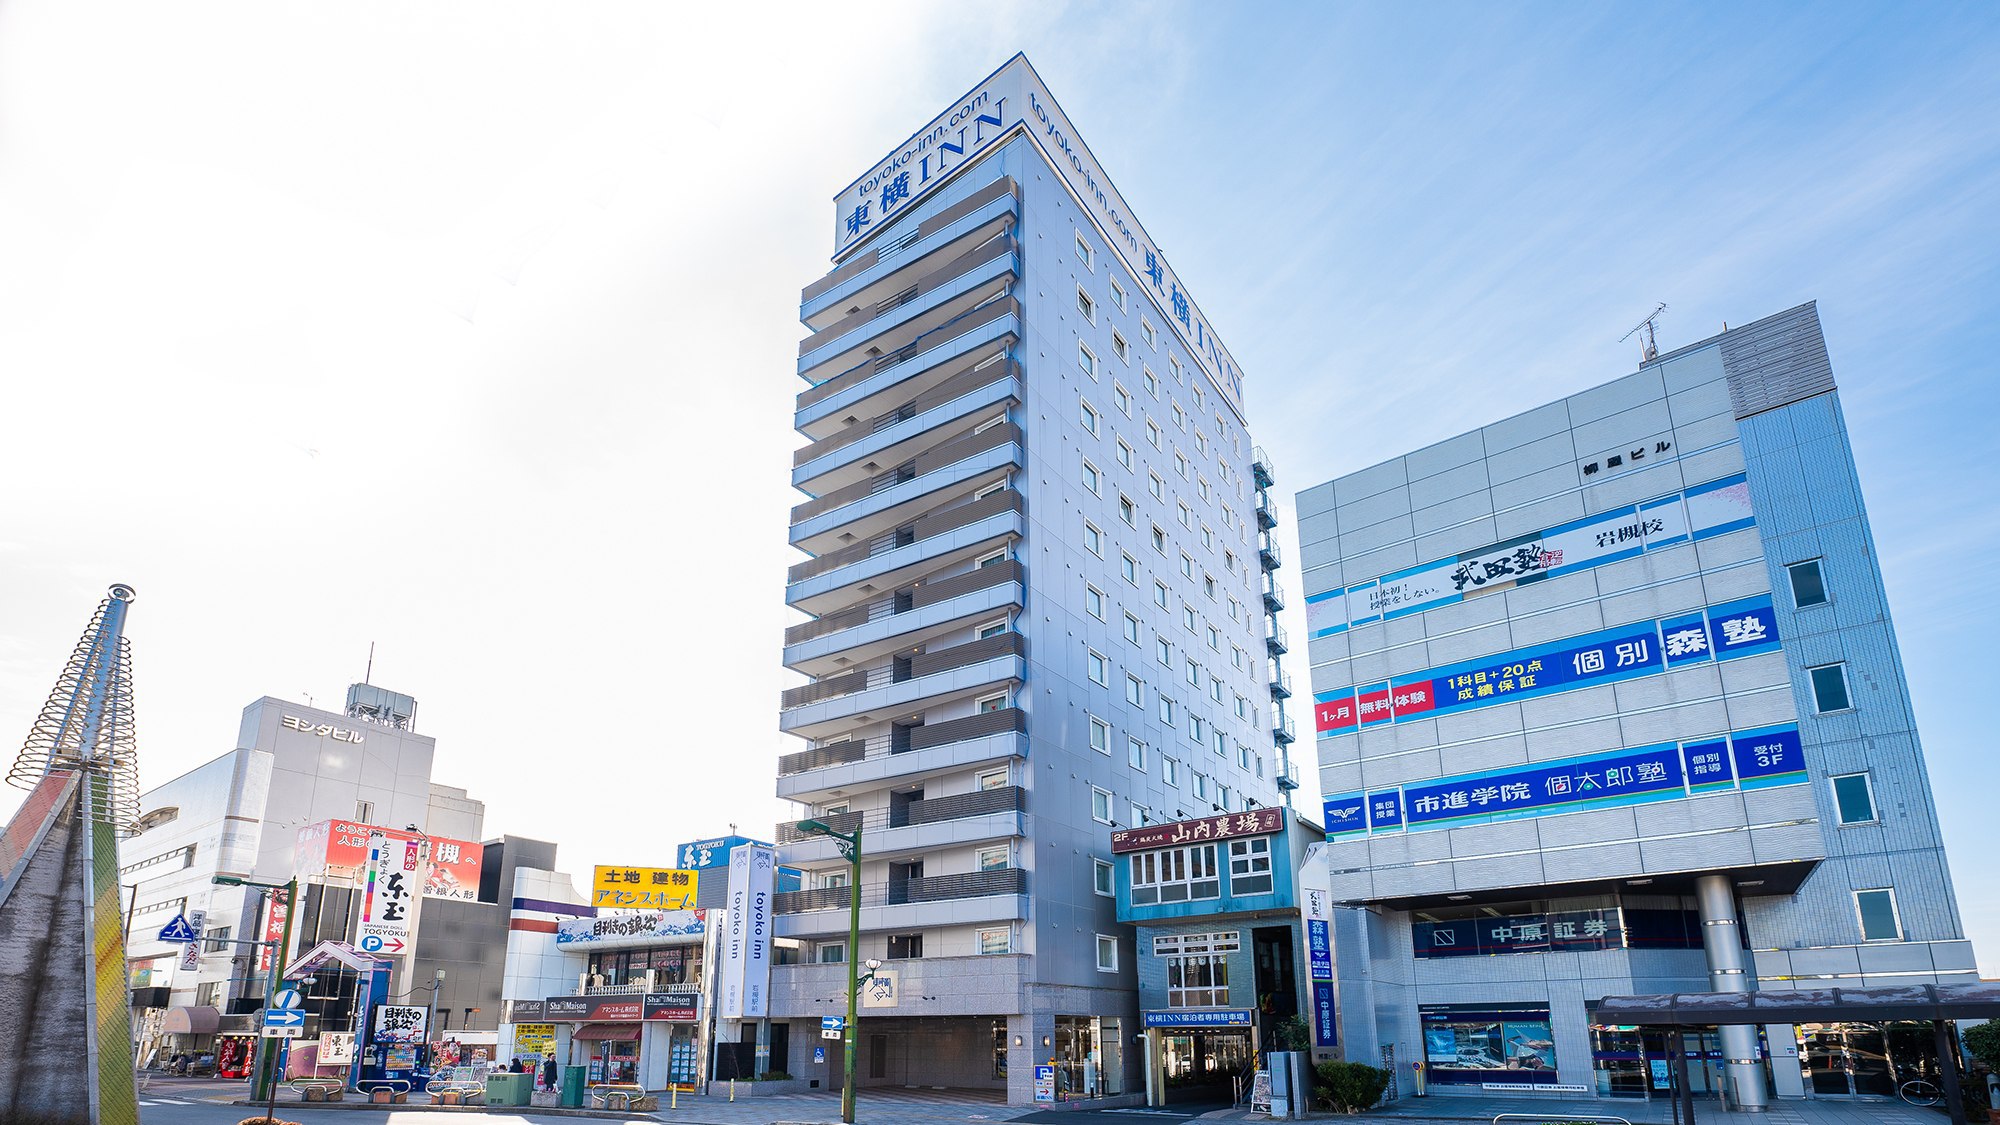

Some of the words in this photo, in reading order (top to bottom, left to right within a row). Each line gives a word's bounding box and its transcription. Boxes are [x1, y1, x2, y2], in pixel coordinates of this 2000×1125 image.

[858, 91, 990, 198] toyoko-inn.com
[1029, 92, 1138, 254] toyoko-inn.com
[1596, 518, 1664, 549] 岩槻校
[1451, 544, 1545, 591] 武田塾
[1457, 675, 1537, 701] 成績保証
[282, 715, 364, 744] ヨシダビル
[1692, 752, 1719, 766] 個別
[1753, 742, 1784, 756] 受付
[1757, 753, 1783, 767] 3F
[1694, 760, 1722, 774] 指導
[1415, 781, 1532, 814] 市進学院
[1545, 761, 1667, 797] 個太郎塾
[1375, 801, 1395, 811] 集団
[1376, 809, 1395, 819] 授業
[1113, 832, 1129, 842] 2F
[1172, 812, 1260, 843] 山内農場
[337, 835, 369, 848] 人形
[405, 848, 416, 871] 人形の
[604, 870, 641, 884] 土地
[652, 871, 690, 886] 建物
[596, 889, 695, 907] アネシスホーム
[732, 891, 742, 935] toyoko
[754, 891, 766, 935] toyoko
[593, 914, 657, 936] 目利きの銀次
[1312, 921, 1324, 950] 森塾
[1491, 919, 1609, 943] 中原証券
[732, 939, 741, 959] inn
[754, 940, 765, 959] inn
[383, 1018, 414, 1031] 銀次
[385, 1007, 422, 1020] 目利きの
[1321, 1001, 1331, 1039] 中原証券
